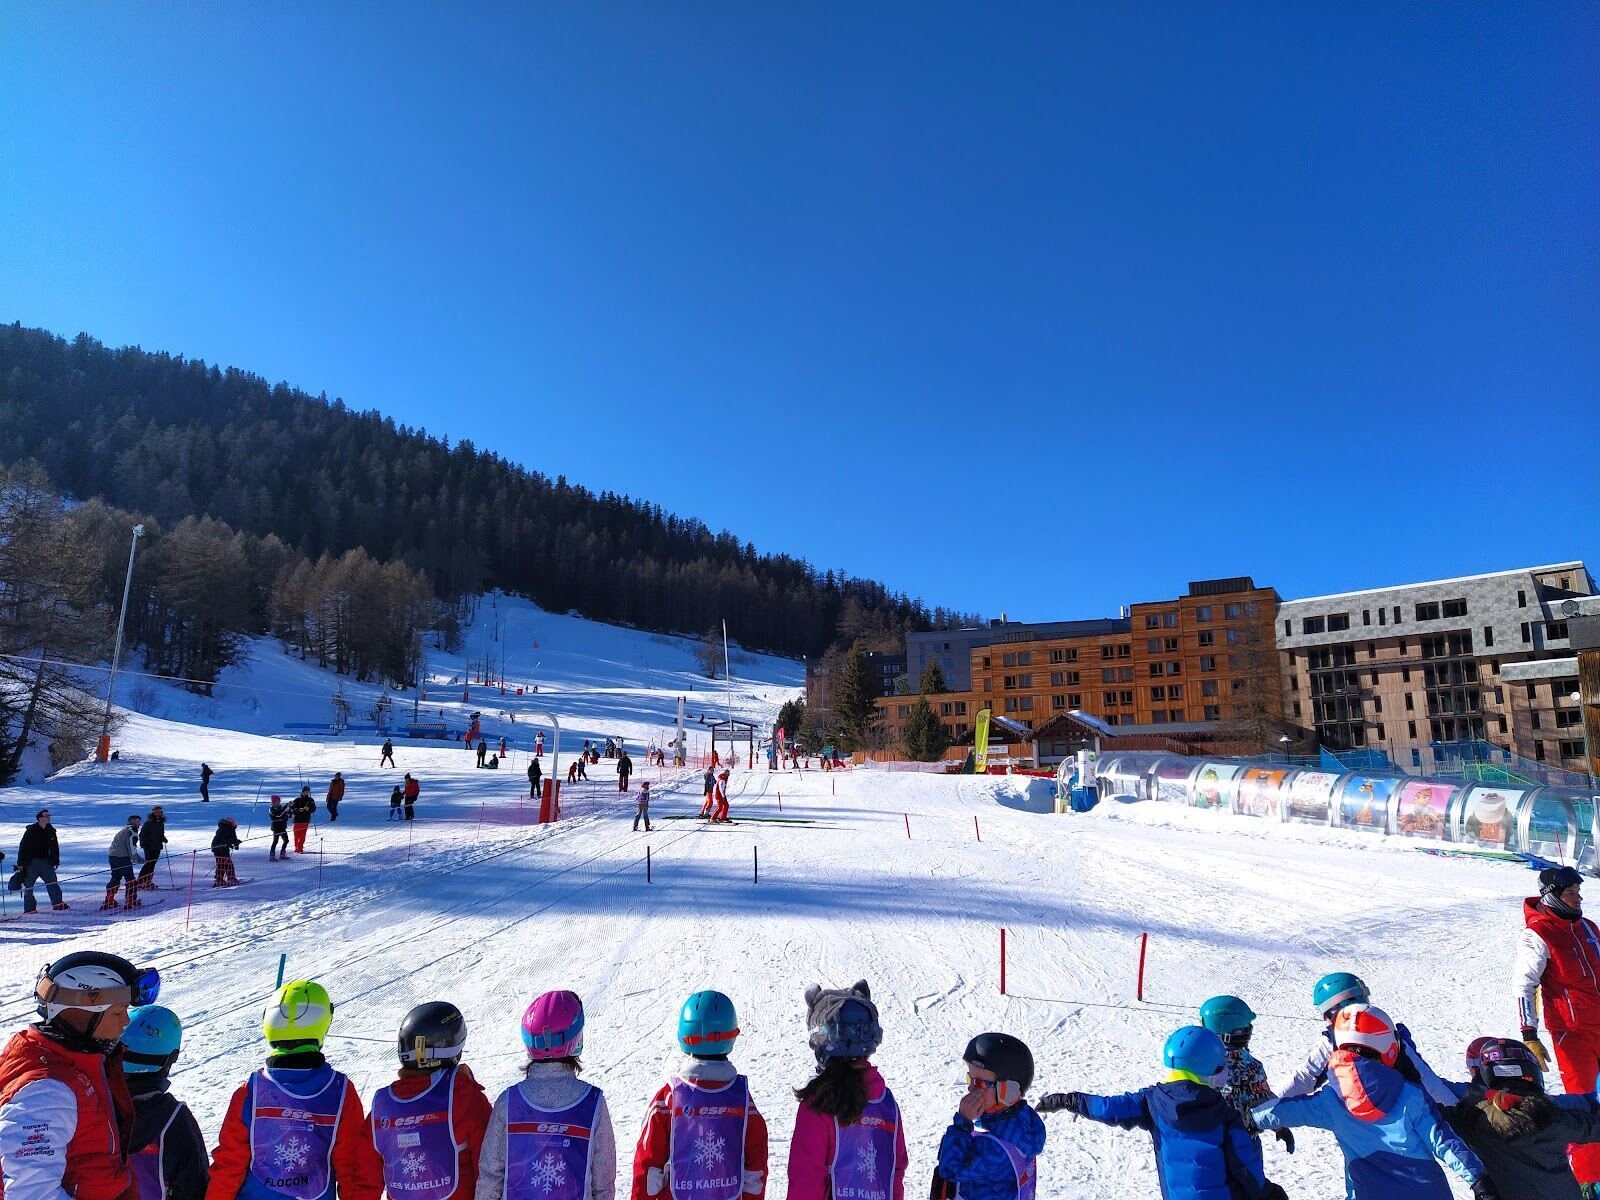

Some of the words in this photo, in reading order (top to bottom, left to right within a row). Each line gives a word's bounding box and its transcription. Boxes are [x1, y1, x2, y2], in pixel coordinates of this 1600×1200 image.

[264, 1176, 310, 1188] FLOCON
[404, 1176, 451, 1191] KARELLIS
[675, 1180, 693, 1190] LES
[696, 1176, 738, 1190] KARELLIS
[837, 1188, 855, 1197] LES
